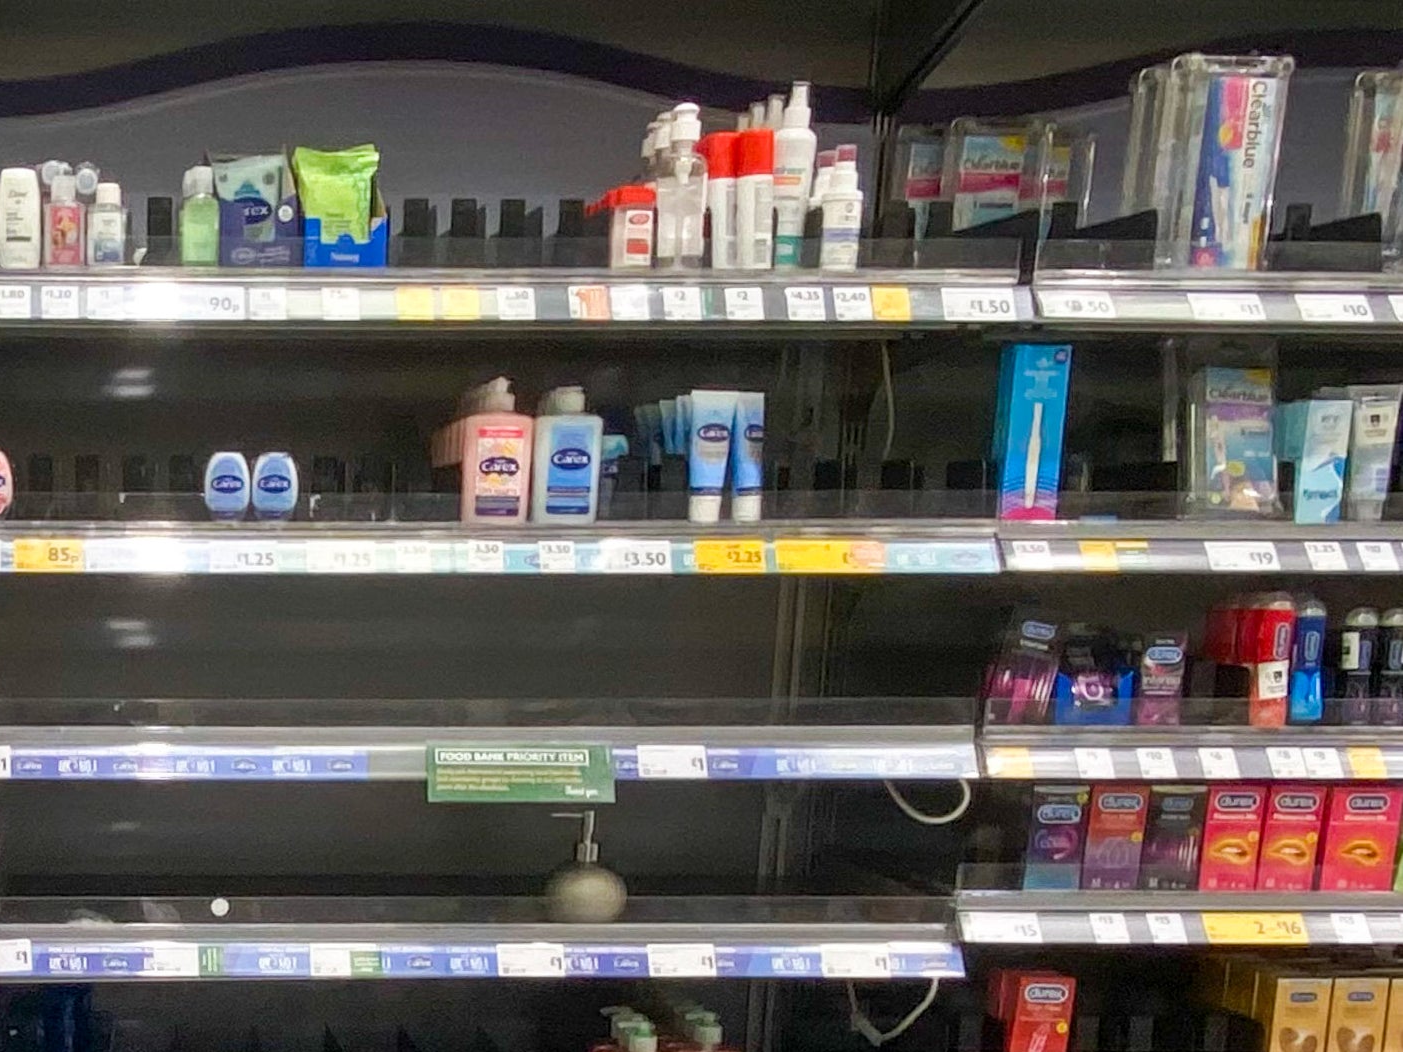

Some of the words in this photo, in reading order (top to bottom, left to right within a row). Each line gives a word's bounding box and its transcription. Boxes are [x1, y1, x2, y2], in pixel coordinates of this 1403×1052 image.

[1241, 80, 1267, 169] Clearblue
[244, 206, 268, 216] rex
[209, 297, 239, 312] 90p
[971, 300, 1009, 313] £1.50
[1343, 304, 1367, 317] £10
[553, 454, 588, 464] Carex
[481, 462, 517, 472] Carex
[48, 547, 78, 564] 85p
[238, 552, 274, 566] £1.25
[624, 552, 666, 567] £3.50
[1250, 553, 1273, 565] £19
[440, 752, 472, 761] FOOD
[474, 752, 504, 761] BANK
[507, 753, 556, 762] PRIORITY
[1103, 797, 1137, 808] durex
[1220, 795, 1254, 807] durex
[1280, 796, 1314, 807] durex
[1351, 796, 1384, 808] durex
[16, 951, 27, 963] £1
[550, 956, 561, 970] £1
[1029, 987, 1063, 999] durex
